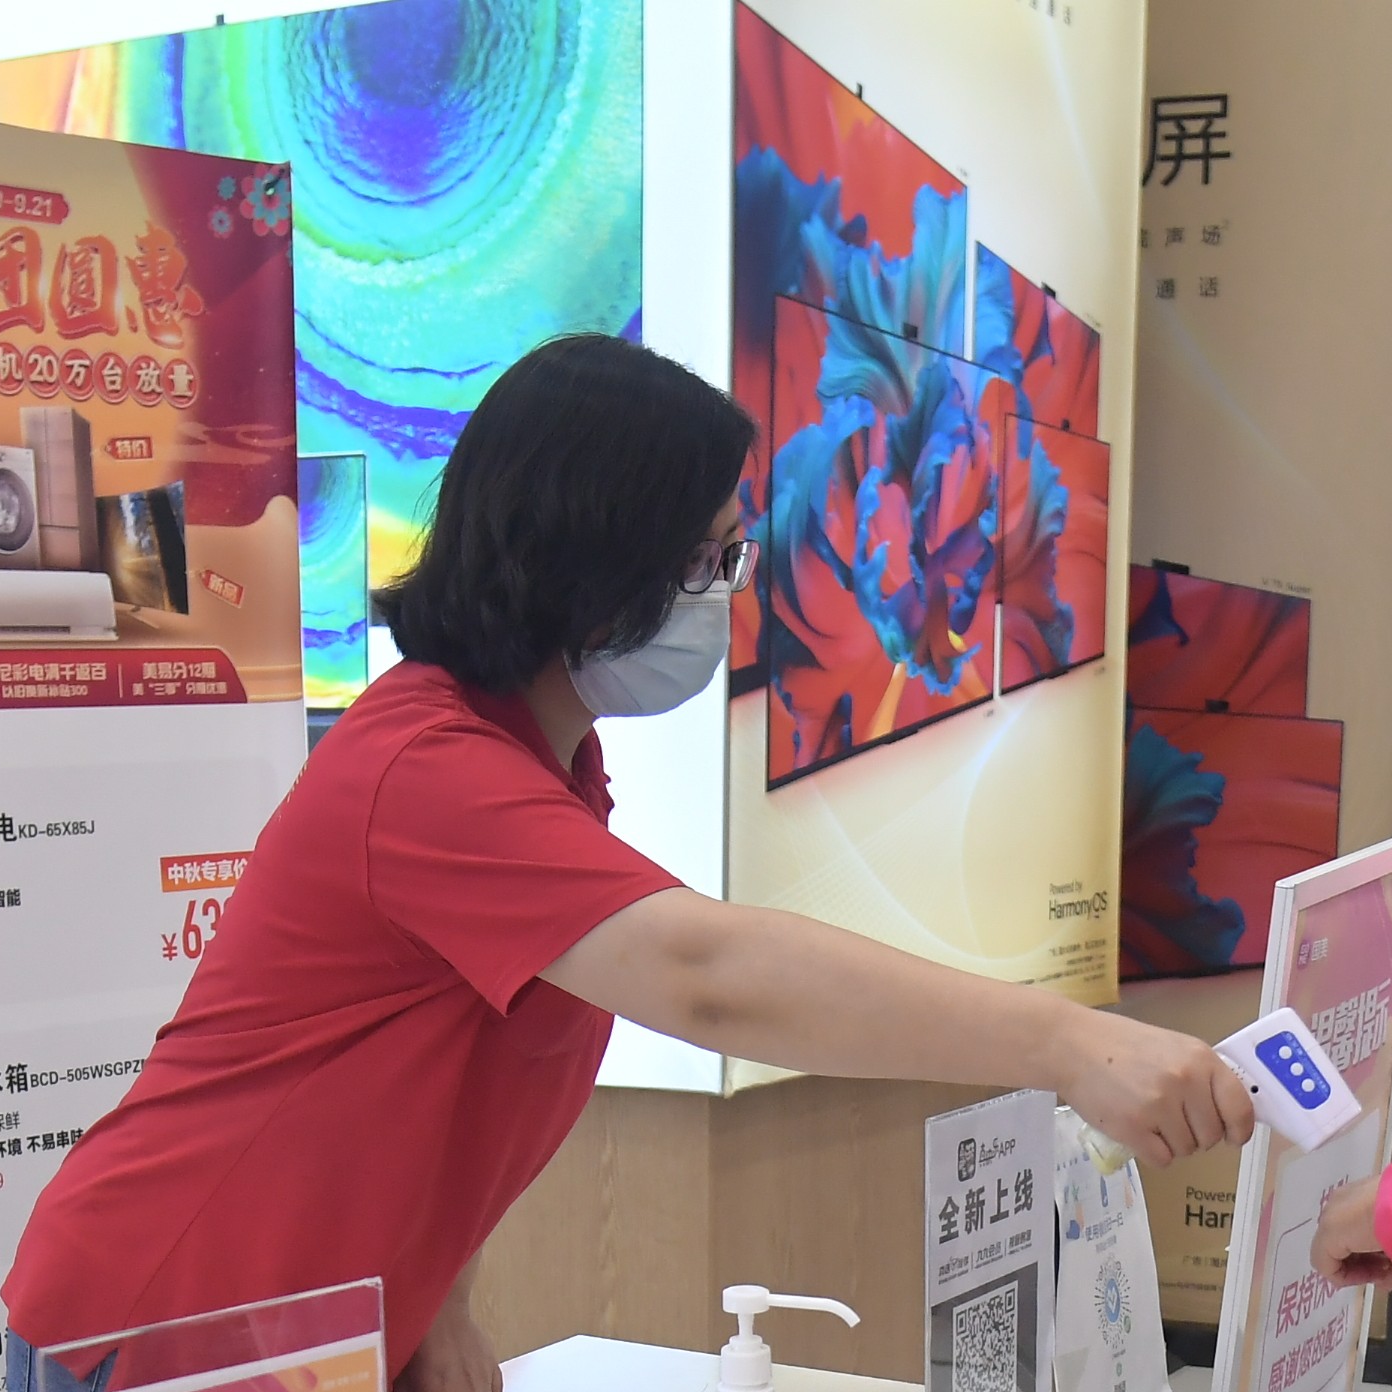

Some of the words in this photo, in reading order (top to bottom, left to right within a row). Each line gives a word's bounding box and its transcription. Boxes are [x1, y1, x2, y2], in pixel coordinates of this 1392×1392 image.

[1141, 93, 1231, 187] 屏
[115, 438, 150, 459] 特价
[207, 575, 239, 601] 新品
[938, 1167, 1034, 1246] 全新上线
[1184, 1203, 1235, 1229] Har
